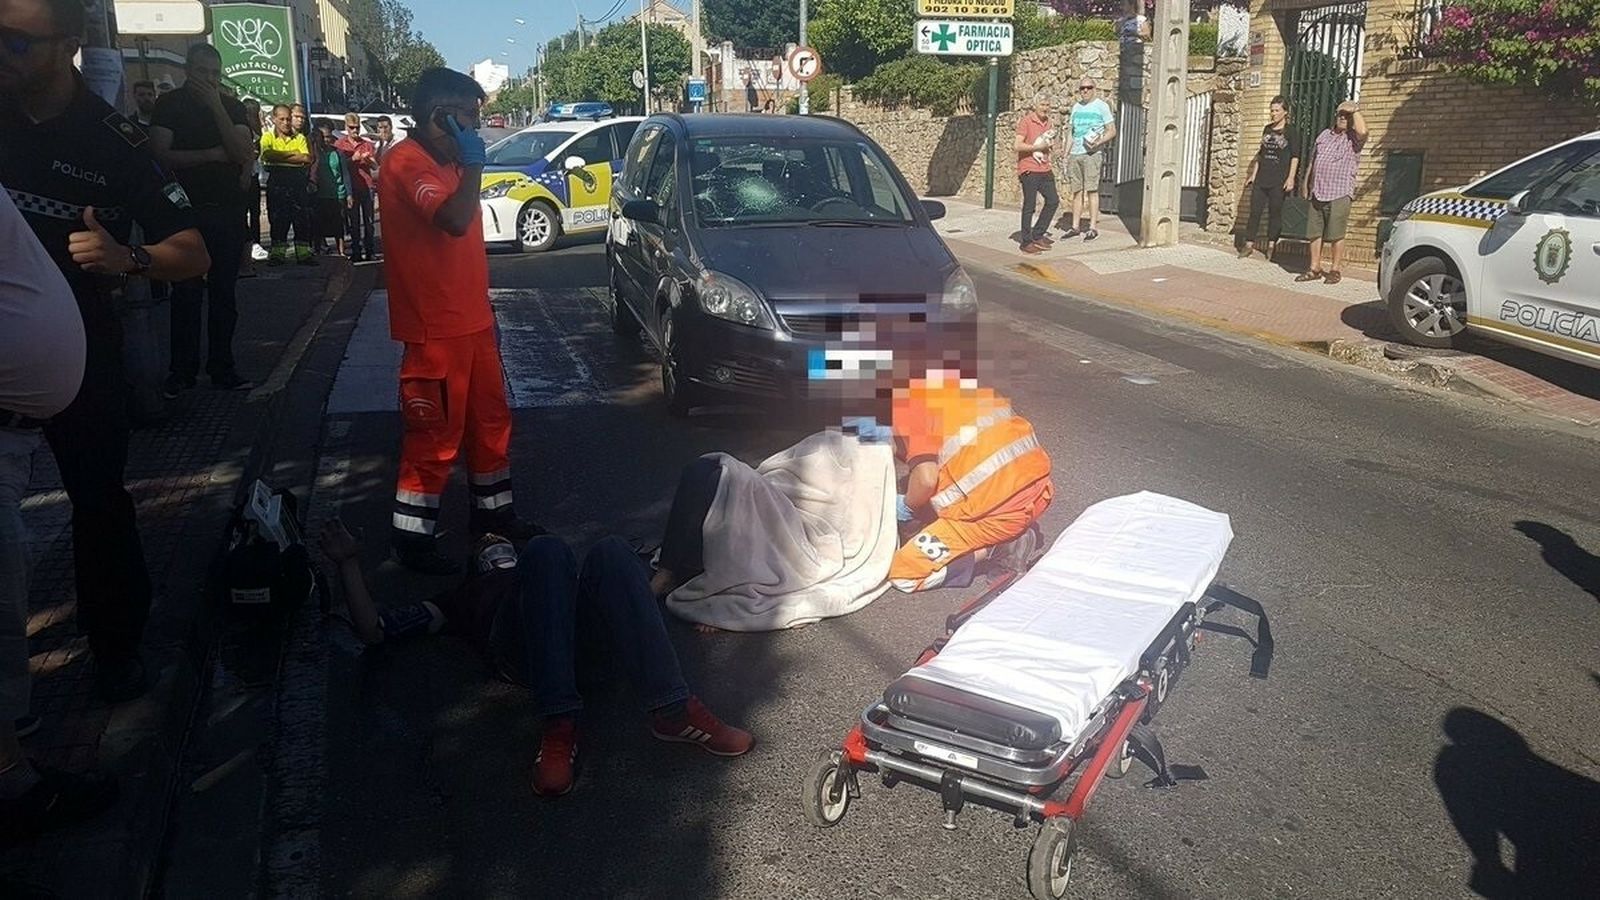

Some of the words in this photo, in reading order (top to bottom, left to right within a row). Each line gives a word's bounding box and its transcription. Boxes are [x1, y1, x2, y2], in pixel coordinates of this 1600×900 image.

[958, 25, 1010, 38] FARMACIA
[966, 40, 1002, 52] OPTICA
[235, 86, 288, 95] EVILLA
[1500, 300, 1600, 343] POLICÍA
